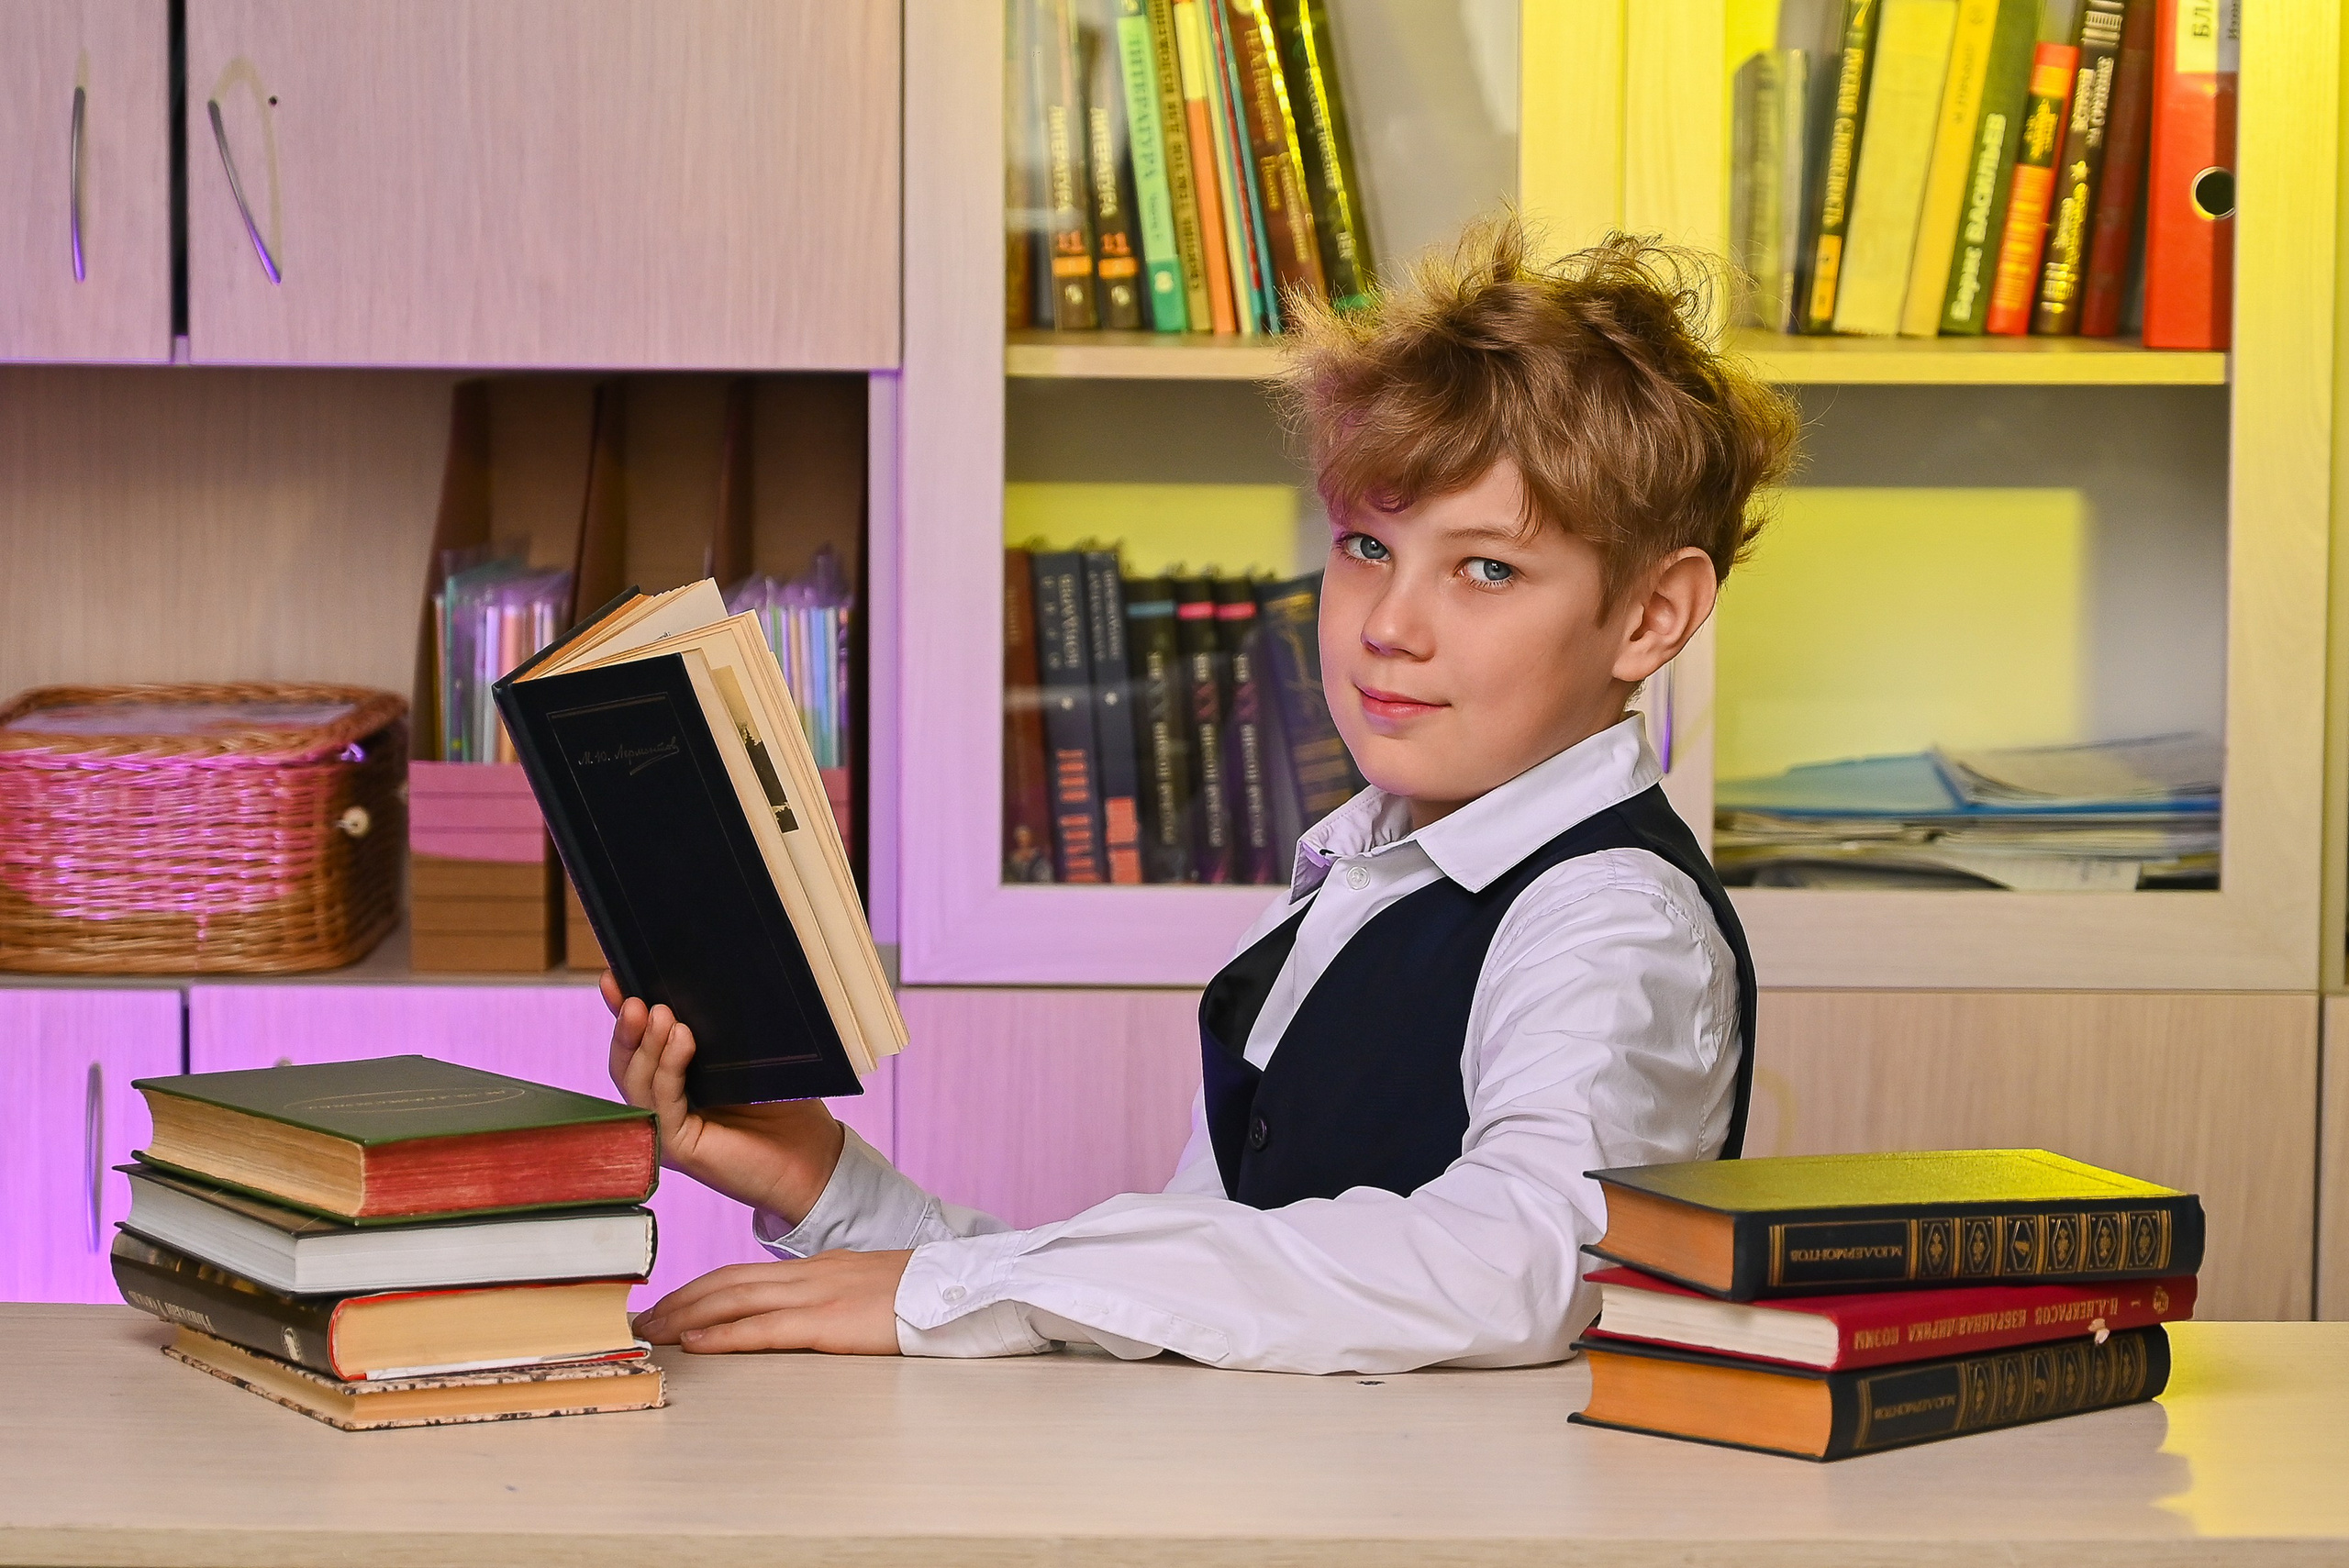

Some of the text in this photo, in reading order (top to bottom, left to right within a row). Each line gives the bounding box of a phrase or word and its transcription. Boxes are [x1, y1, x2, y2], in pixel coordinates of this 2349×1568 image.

[1950, 113, 2008, 321] Борис ВАСИЛЬЕВ
[1854, 1326, 1899, 1351] ПОЭМЫ
